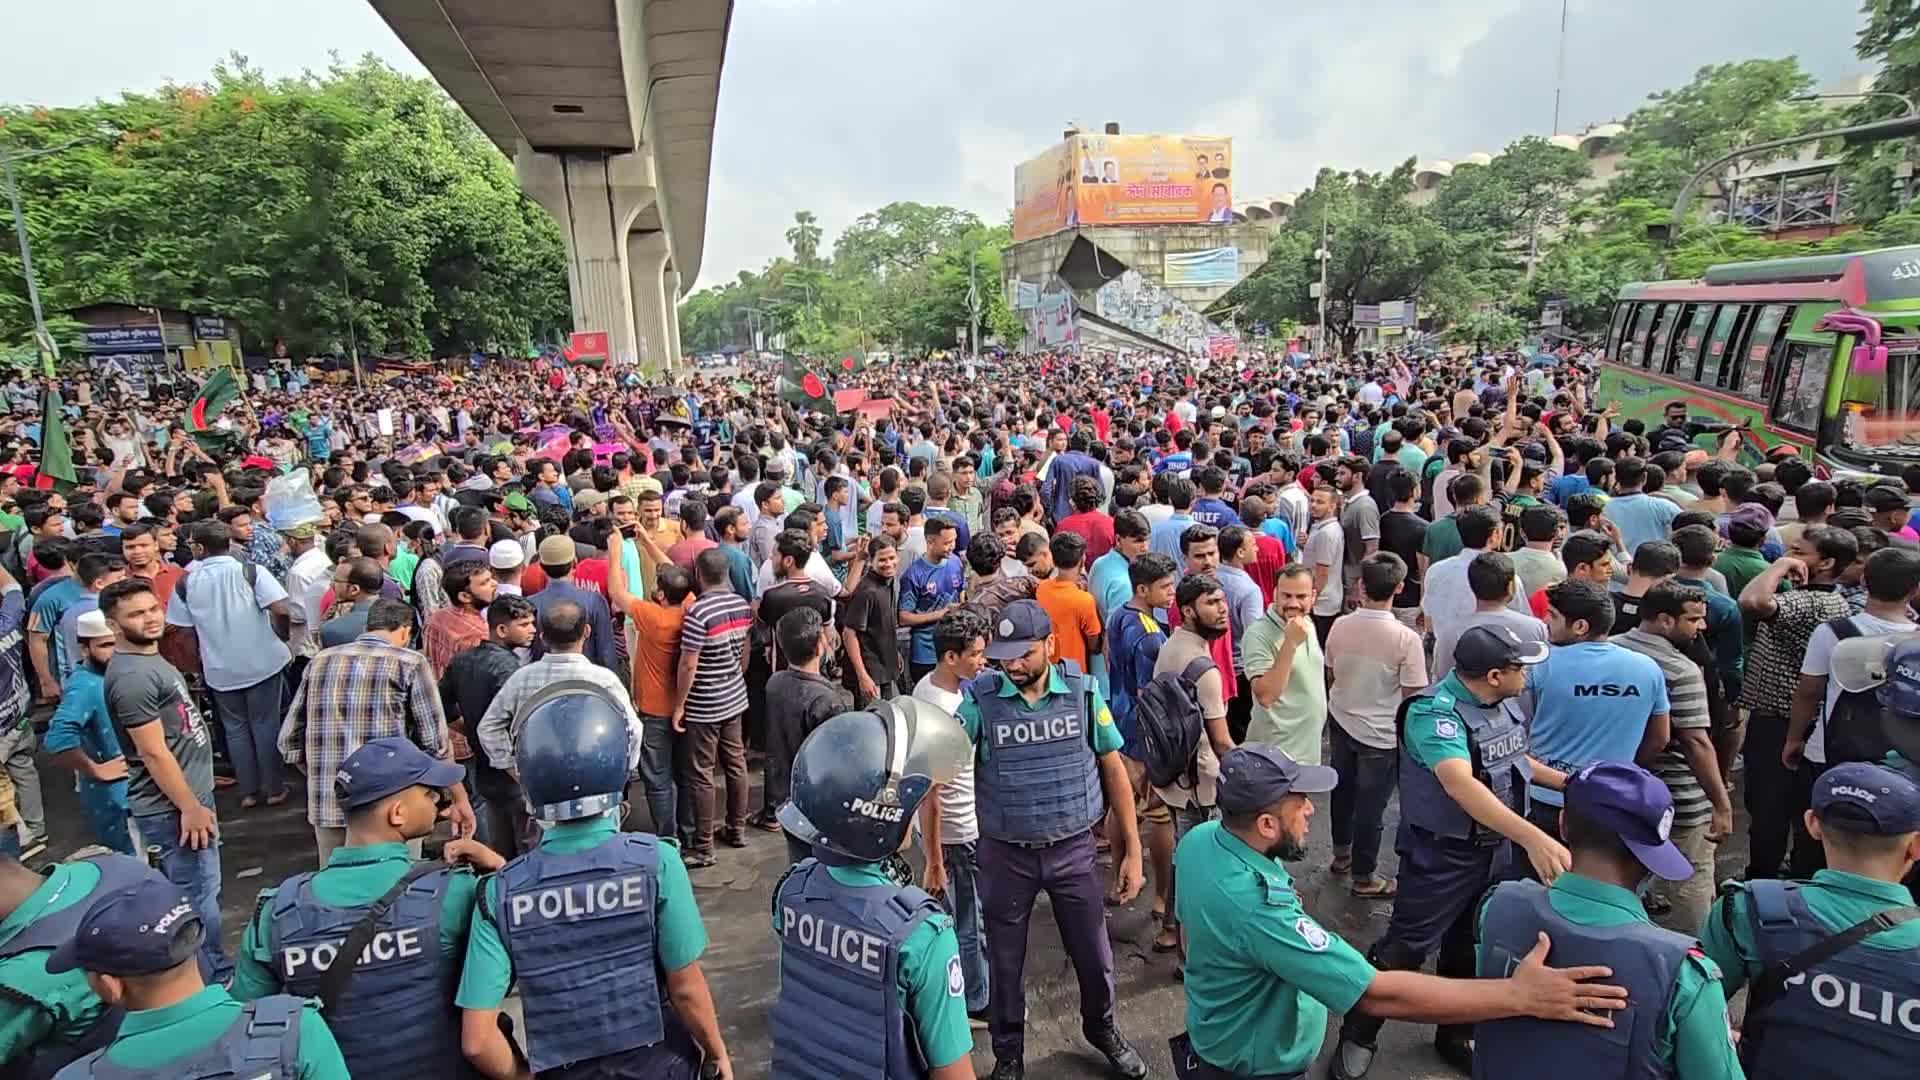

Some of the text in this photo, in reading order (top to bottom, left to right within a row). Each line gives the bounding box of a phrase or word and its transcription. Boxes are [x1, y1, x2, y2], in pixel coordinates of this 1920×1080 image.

[1574, 684, 1641, 697] MSA
[996, 714, 1081, 745] POLICE
[1488, 730, 1524, 761] POLICE
[850, 797, 905, 823] POLICE
[1831, 785, 1878, 804] POLICE
[512, 876, 643, 926] POLICE
[153, 903, 193, 934] POLICE
[284, 927, 423, 977] POICE
[783, 906, 883, 974] POLICE
